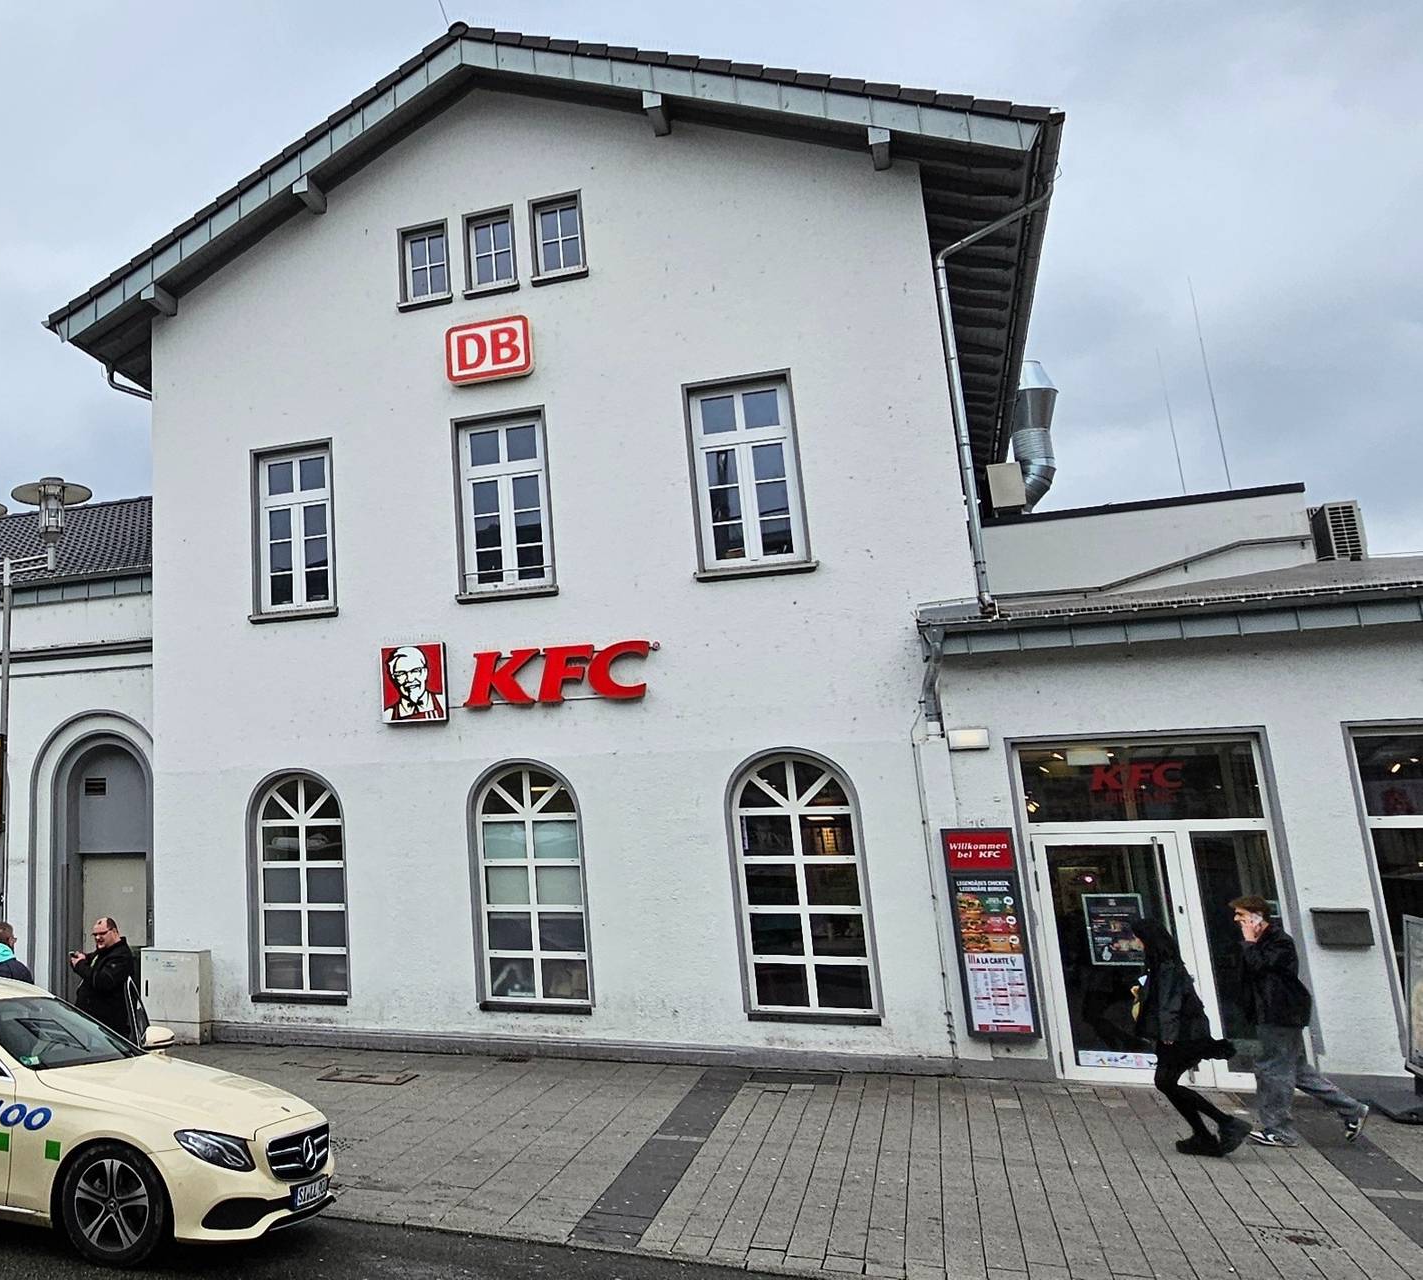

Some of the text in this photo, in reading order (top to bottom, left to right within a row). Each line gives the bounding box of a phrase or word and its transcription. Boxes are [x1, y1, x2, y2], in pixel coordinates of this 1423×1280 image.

[457, 326, 521, 372] DB
[464, 640, 650, 708] KFC
[1090, 760, 1185, 792] KFC
[957, 851, 973, 859] bei
